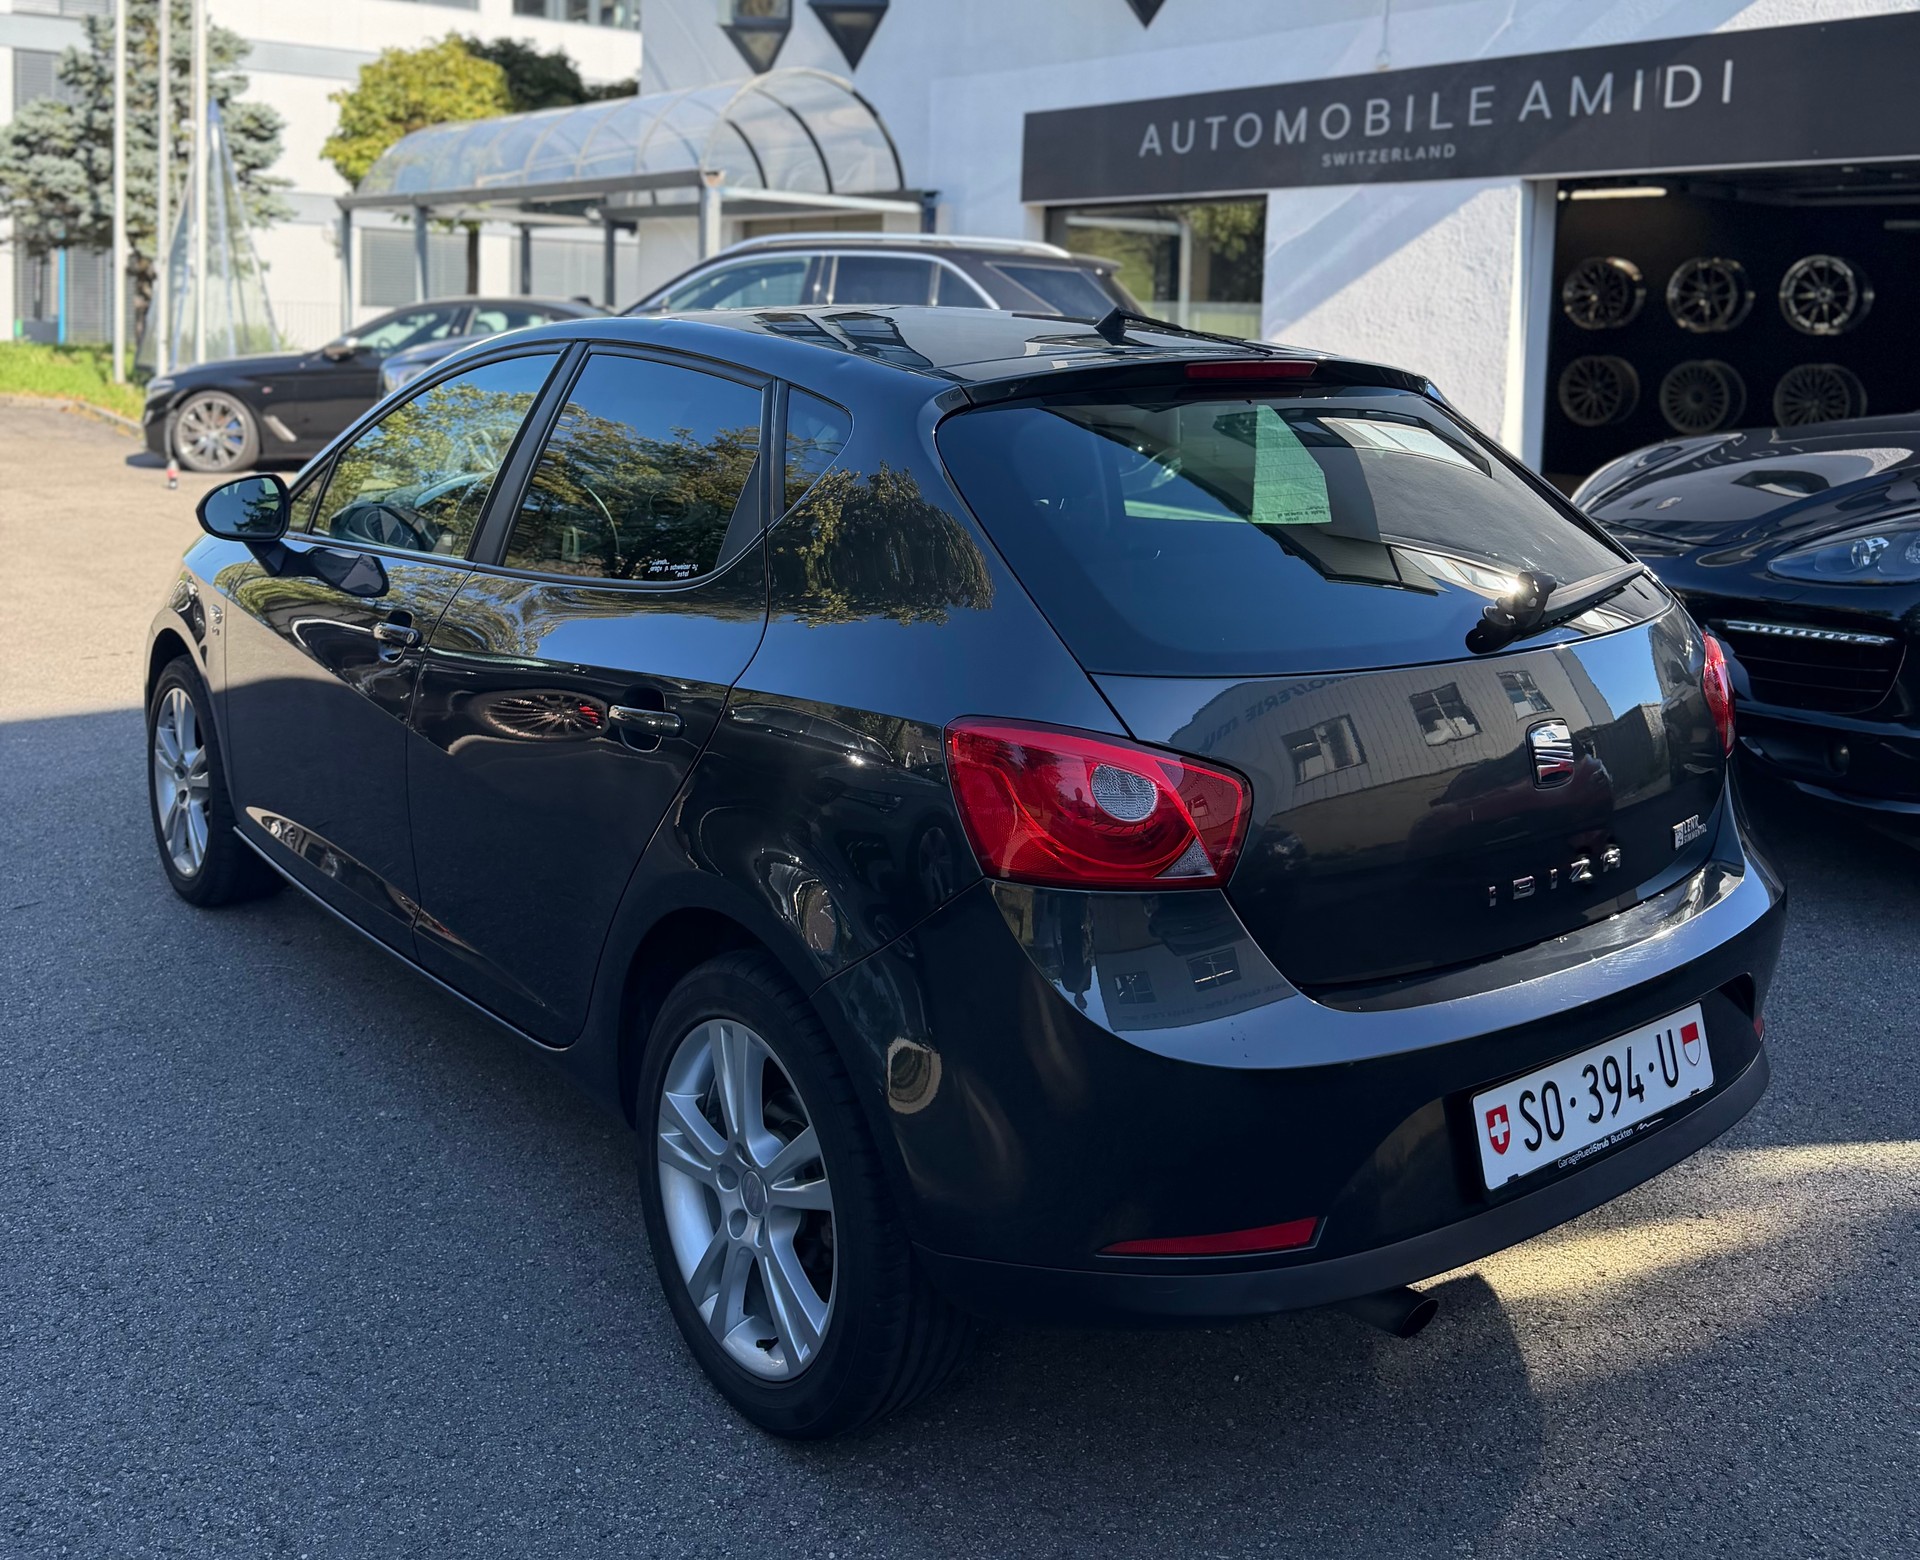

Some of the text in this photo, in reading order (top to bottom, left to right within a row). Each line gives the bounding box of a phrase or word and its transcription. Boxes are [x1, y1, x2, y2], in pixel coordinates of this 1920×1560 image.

[1139, 59, 1734, 158] AUTOMOBILE AMIDI
[1321, 143, 1457, 168] SWITZERLAND
[1488, 846, 1621, 907] IBIZA
[1610, 1129, 1633, 1144] Buckten
